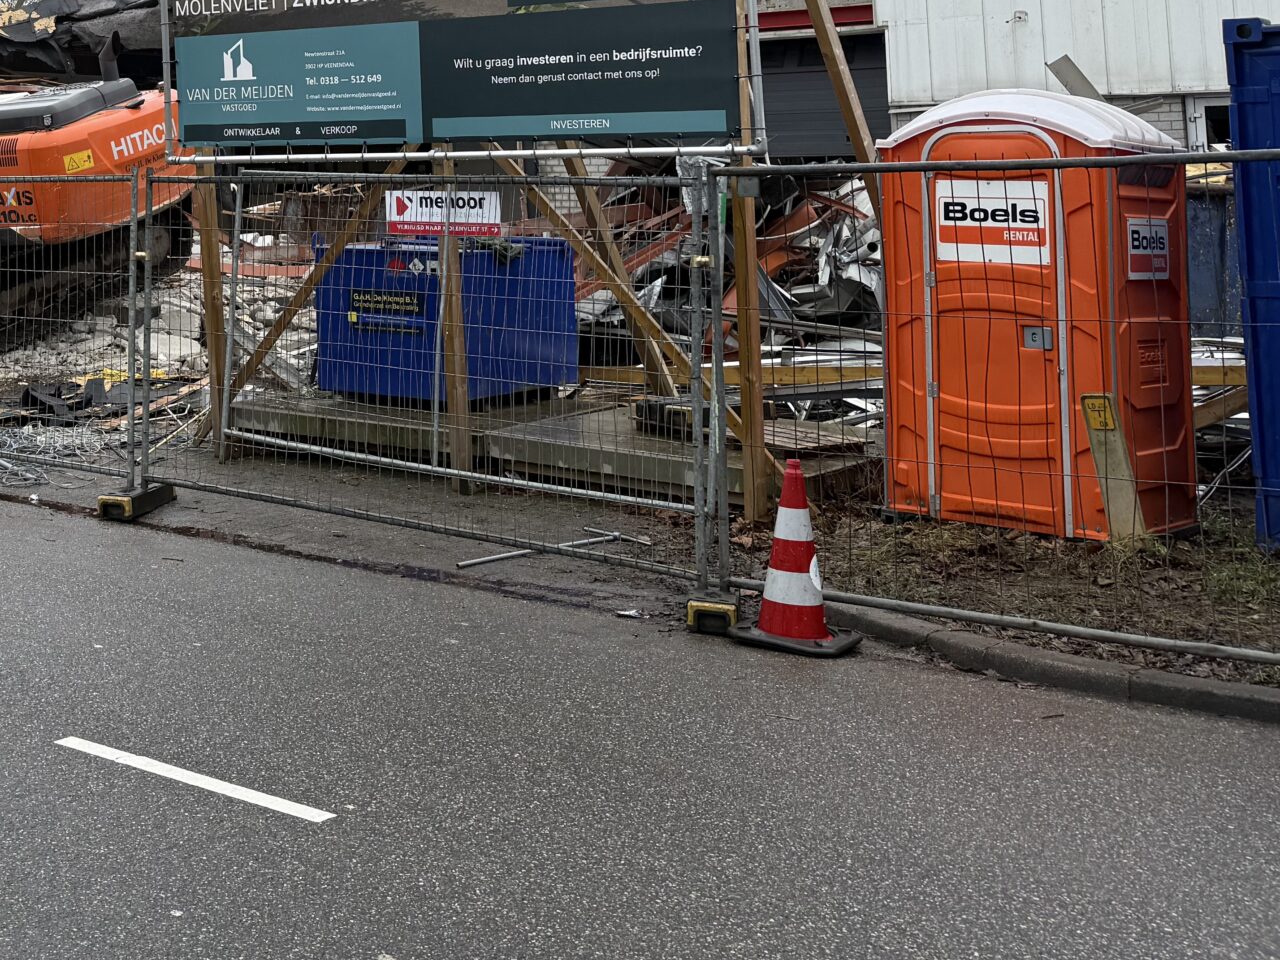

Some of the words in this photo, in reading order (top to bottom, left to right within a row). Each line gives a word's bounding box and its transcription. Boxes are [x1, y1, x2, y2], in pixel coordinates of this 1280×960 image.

[454, 58, 473, 69] Wilt
[475, 60, 482, 68] u
[484, 58, 514, 70] graag
[516, 53, 574, 66] investeren
[576, 53, 587, 63] in
[589, 52, 610, 62] een
[612, 45, 703, 62] bedrijfsruimte?
[305, 77, 318, 85] Tel.
[320, 76, 339, 85] 0318
[351, 75, 365, 84] 512
[367, 74, 382, 83] 649
[491, 74, 517, 84] Neem
[518, 73, 535, 83] dan
[537, 72, 566, 84] gerust
[567, 71, 602, 81] contact
[604, 69, 623, 79] met
[625, 69, 643, 78] ons
[644, 68, 660, 80] op!
[187, 88, 210, 101] VAN
[214, 87, 236, 100] DER
[241, 85, 293, 99] MEIJDEN
[222, 103, 257, 112] VASTGOED
[223, 127, 280, 137] ONTWIKKELAAR
[295, 126, 301, 135] &
[320, 125, 358, 135] VERKOOP
[550, 118, 610, 130] INVESTEREN
[943, 201, 1040, 224] Boels
[1003, 230, 1039, 242] RENTAL
[1131, 229, 1166, 251] Boels
